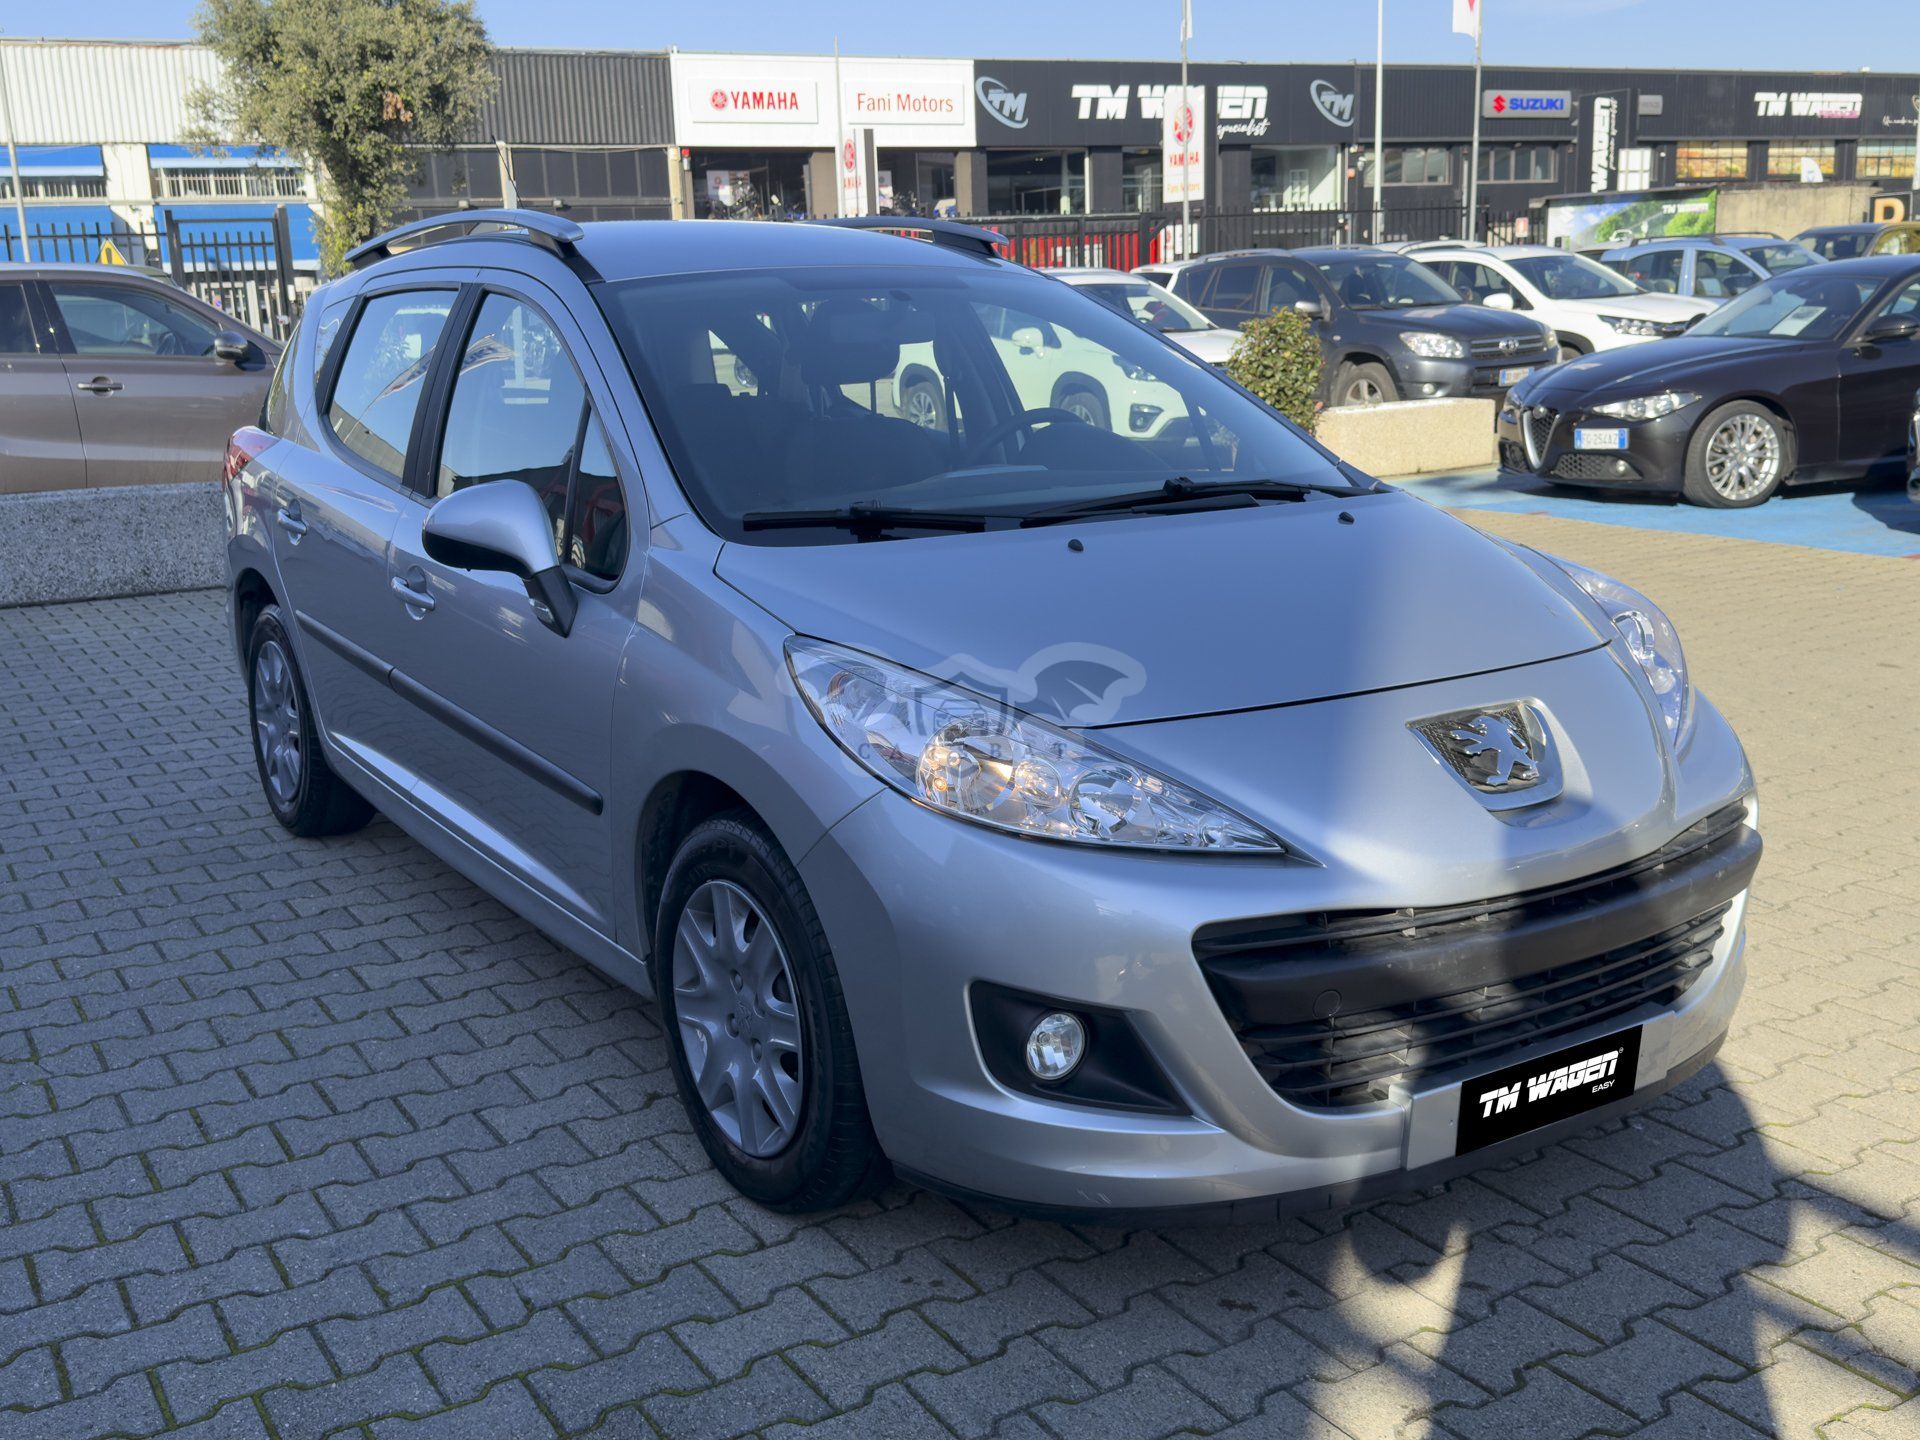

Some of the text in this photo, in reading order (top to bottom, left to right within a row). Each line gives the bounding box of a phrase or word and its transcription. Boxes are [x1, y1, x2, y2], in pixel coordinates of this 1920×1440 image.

[731, 91, 799, 110] YAMAHA
[857, 92, 953, 112] Fani Motors
[1071, 84, 1130, 119] TM
[1509, 97, 1564, 111] SUZUKI
[1754, 92, 1788, 116] TM
[1479, 1050, 1620, 1119] TM WAGEN
[1591, 1079, 1615, 1094] EASY
